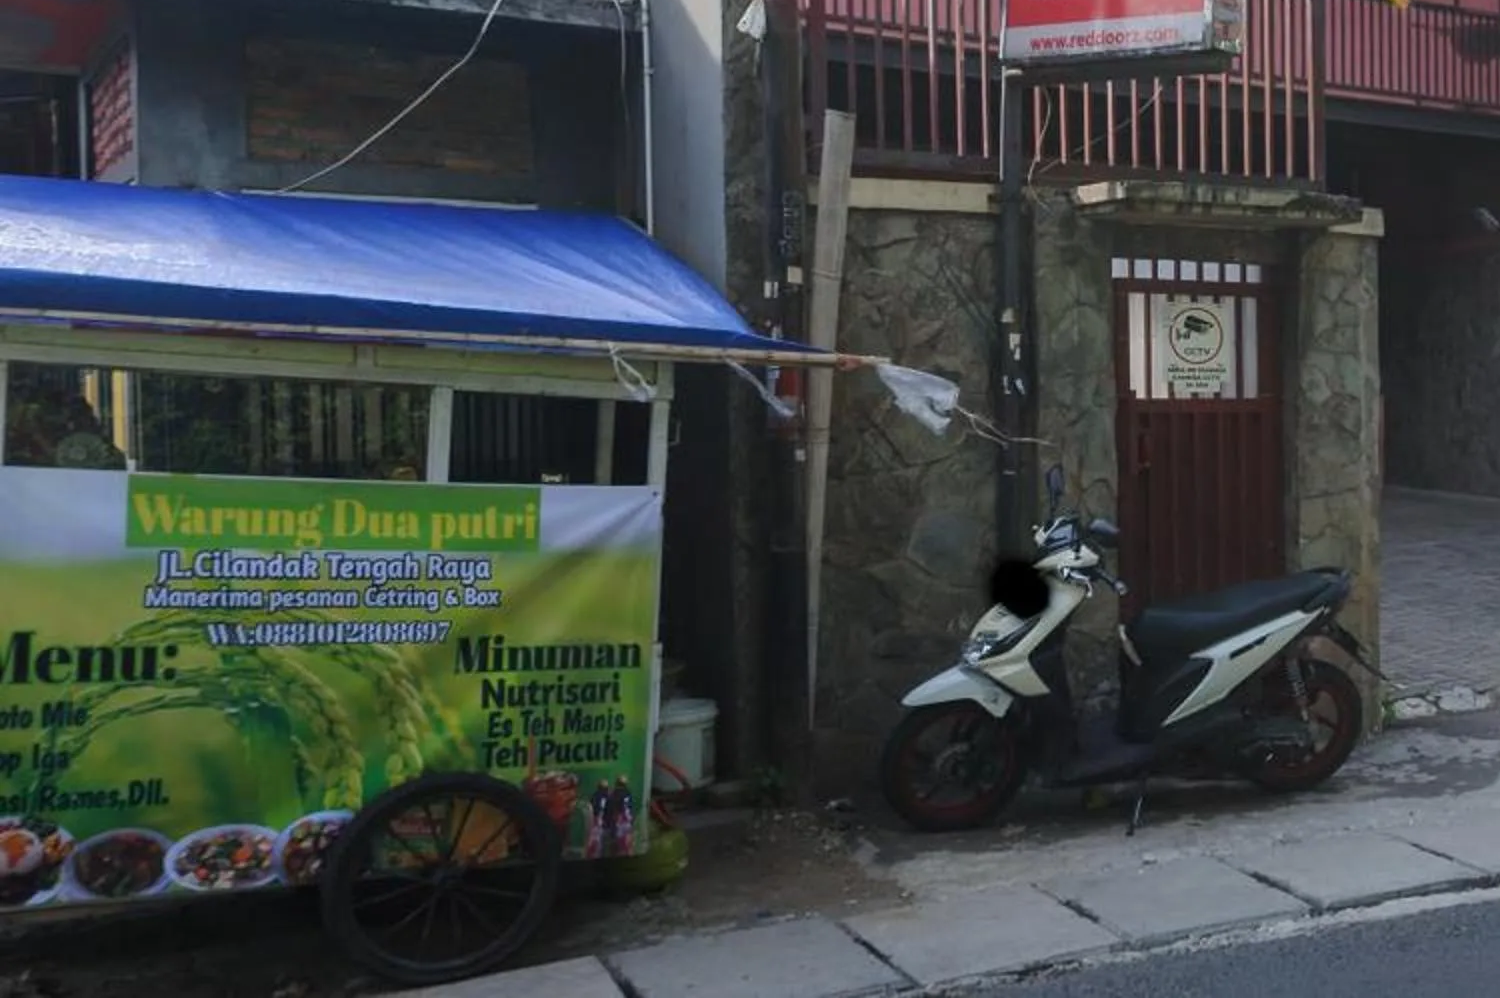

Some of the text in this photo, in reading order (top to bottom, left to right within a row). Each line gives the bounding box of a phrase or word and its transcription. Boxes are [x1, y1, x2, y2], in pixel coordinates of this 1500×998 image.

[1029, 26, 1180, 51] www.reddoorz.com
[133, 493, 537, 550] Warung Dua putri
[325, 553, 421, 586] Tengah
[425, 553, 492, 586] Raya
[143, 585, 502, 614] Manerima pesanan Cetring & Box
[454, 635, 642, 675] Minuman
[480, 674, 622, 709] Nutrisari
[42, 701, 89, 728] Mie
[487, 707, 626, 740] Es Teh Manis
[481, 733, 619, 769] Teh Pucuk
